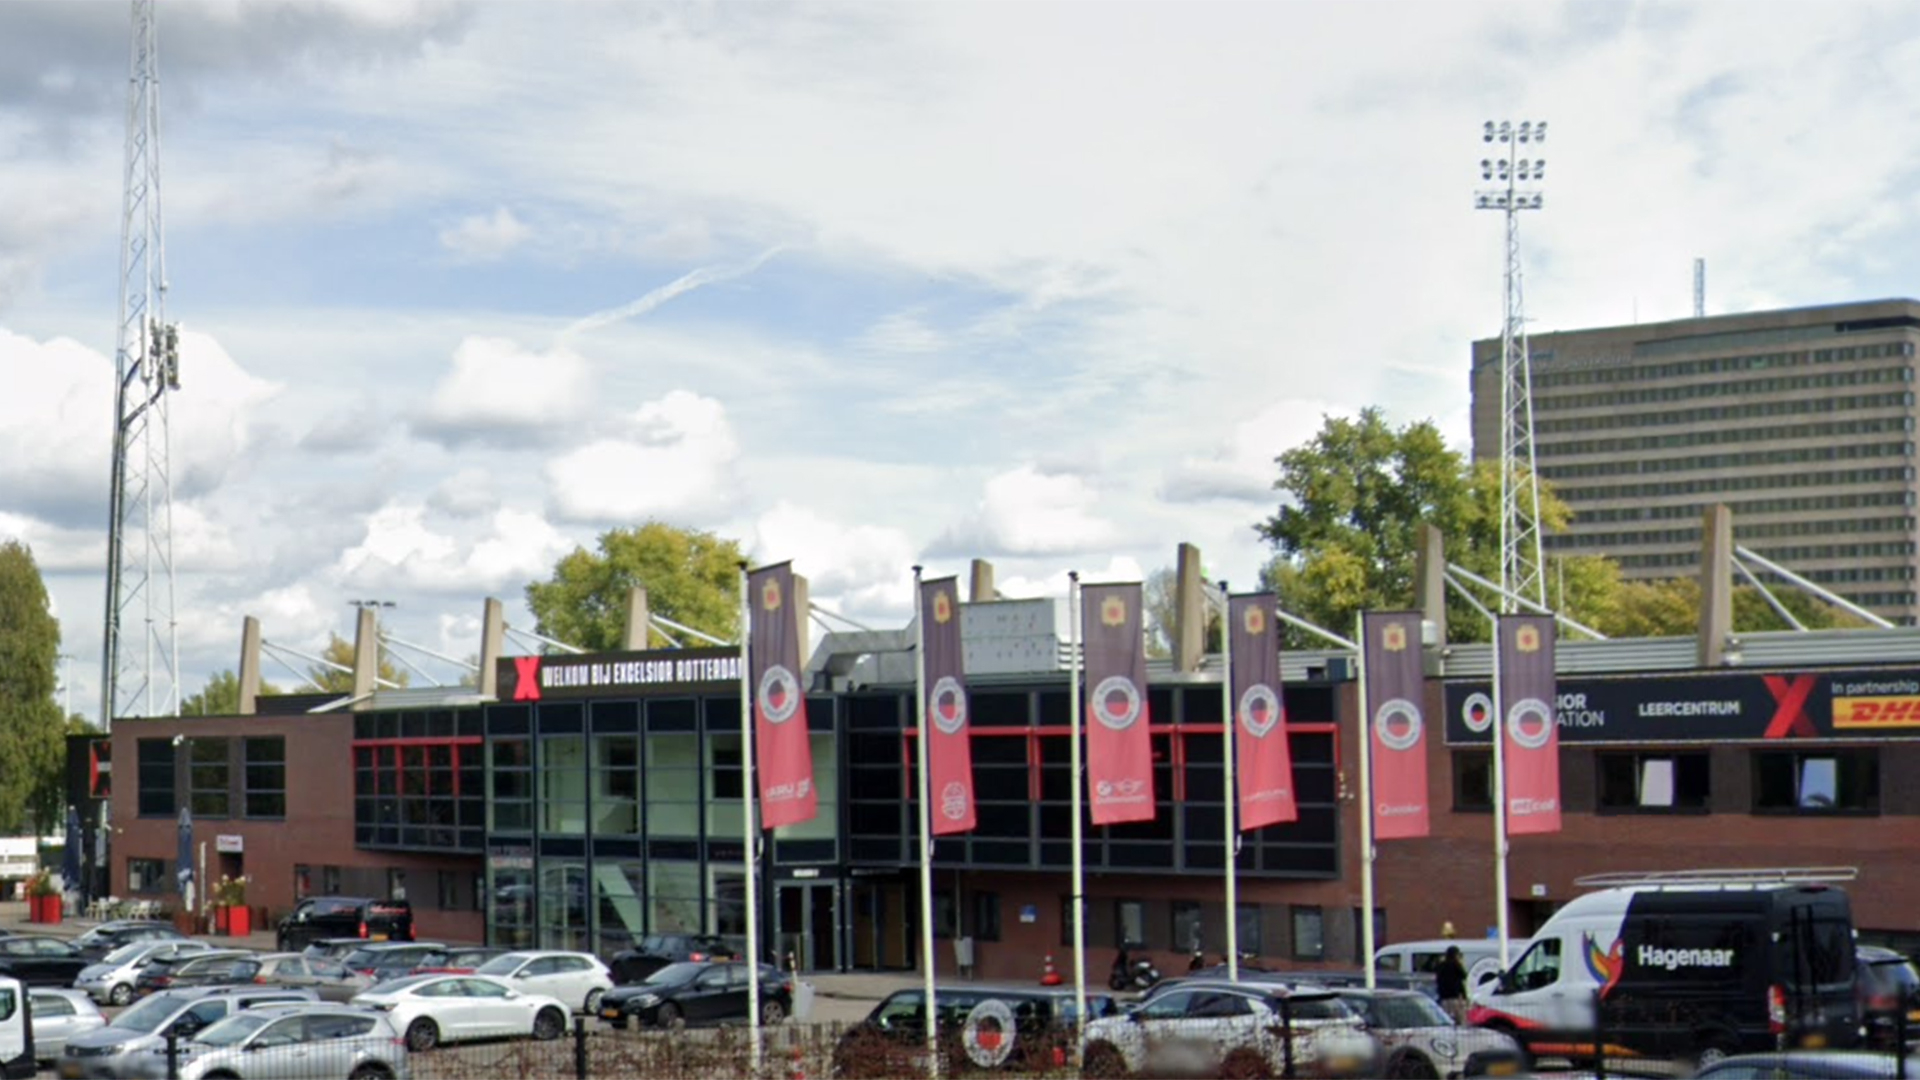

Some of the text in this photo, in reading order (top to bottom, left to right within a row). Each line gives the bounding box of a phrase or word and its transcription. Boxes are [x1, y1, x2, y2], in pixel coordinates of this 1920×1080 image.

[542, 665, 589, 688] WELKOM
[591, 663, 611, 685] BIJ
[613, 660, 673, 684] EXCELSIOR
[1831, 680, 1920, 696] In partnership
[1639, 701, 1740, 716] LEERCENTRUM
[1638, 945, 1734, 970] Hagenaar
